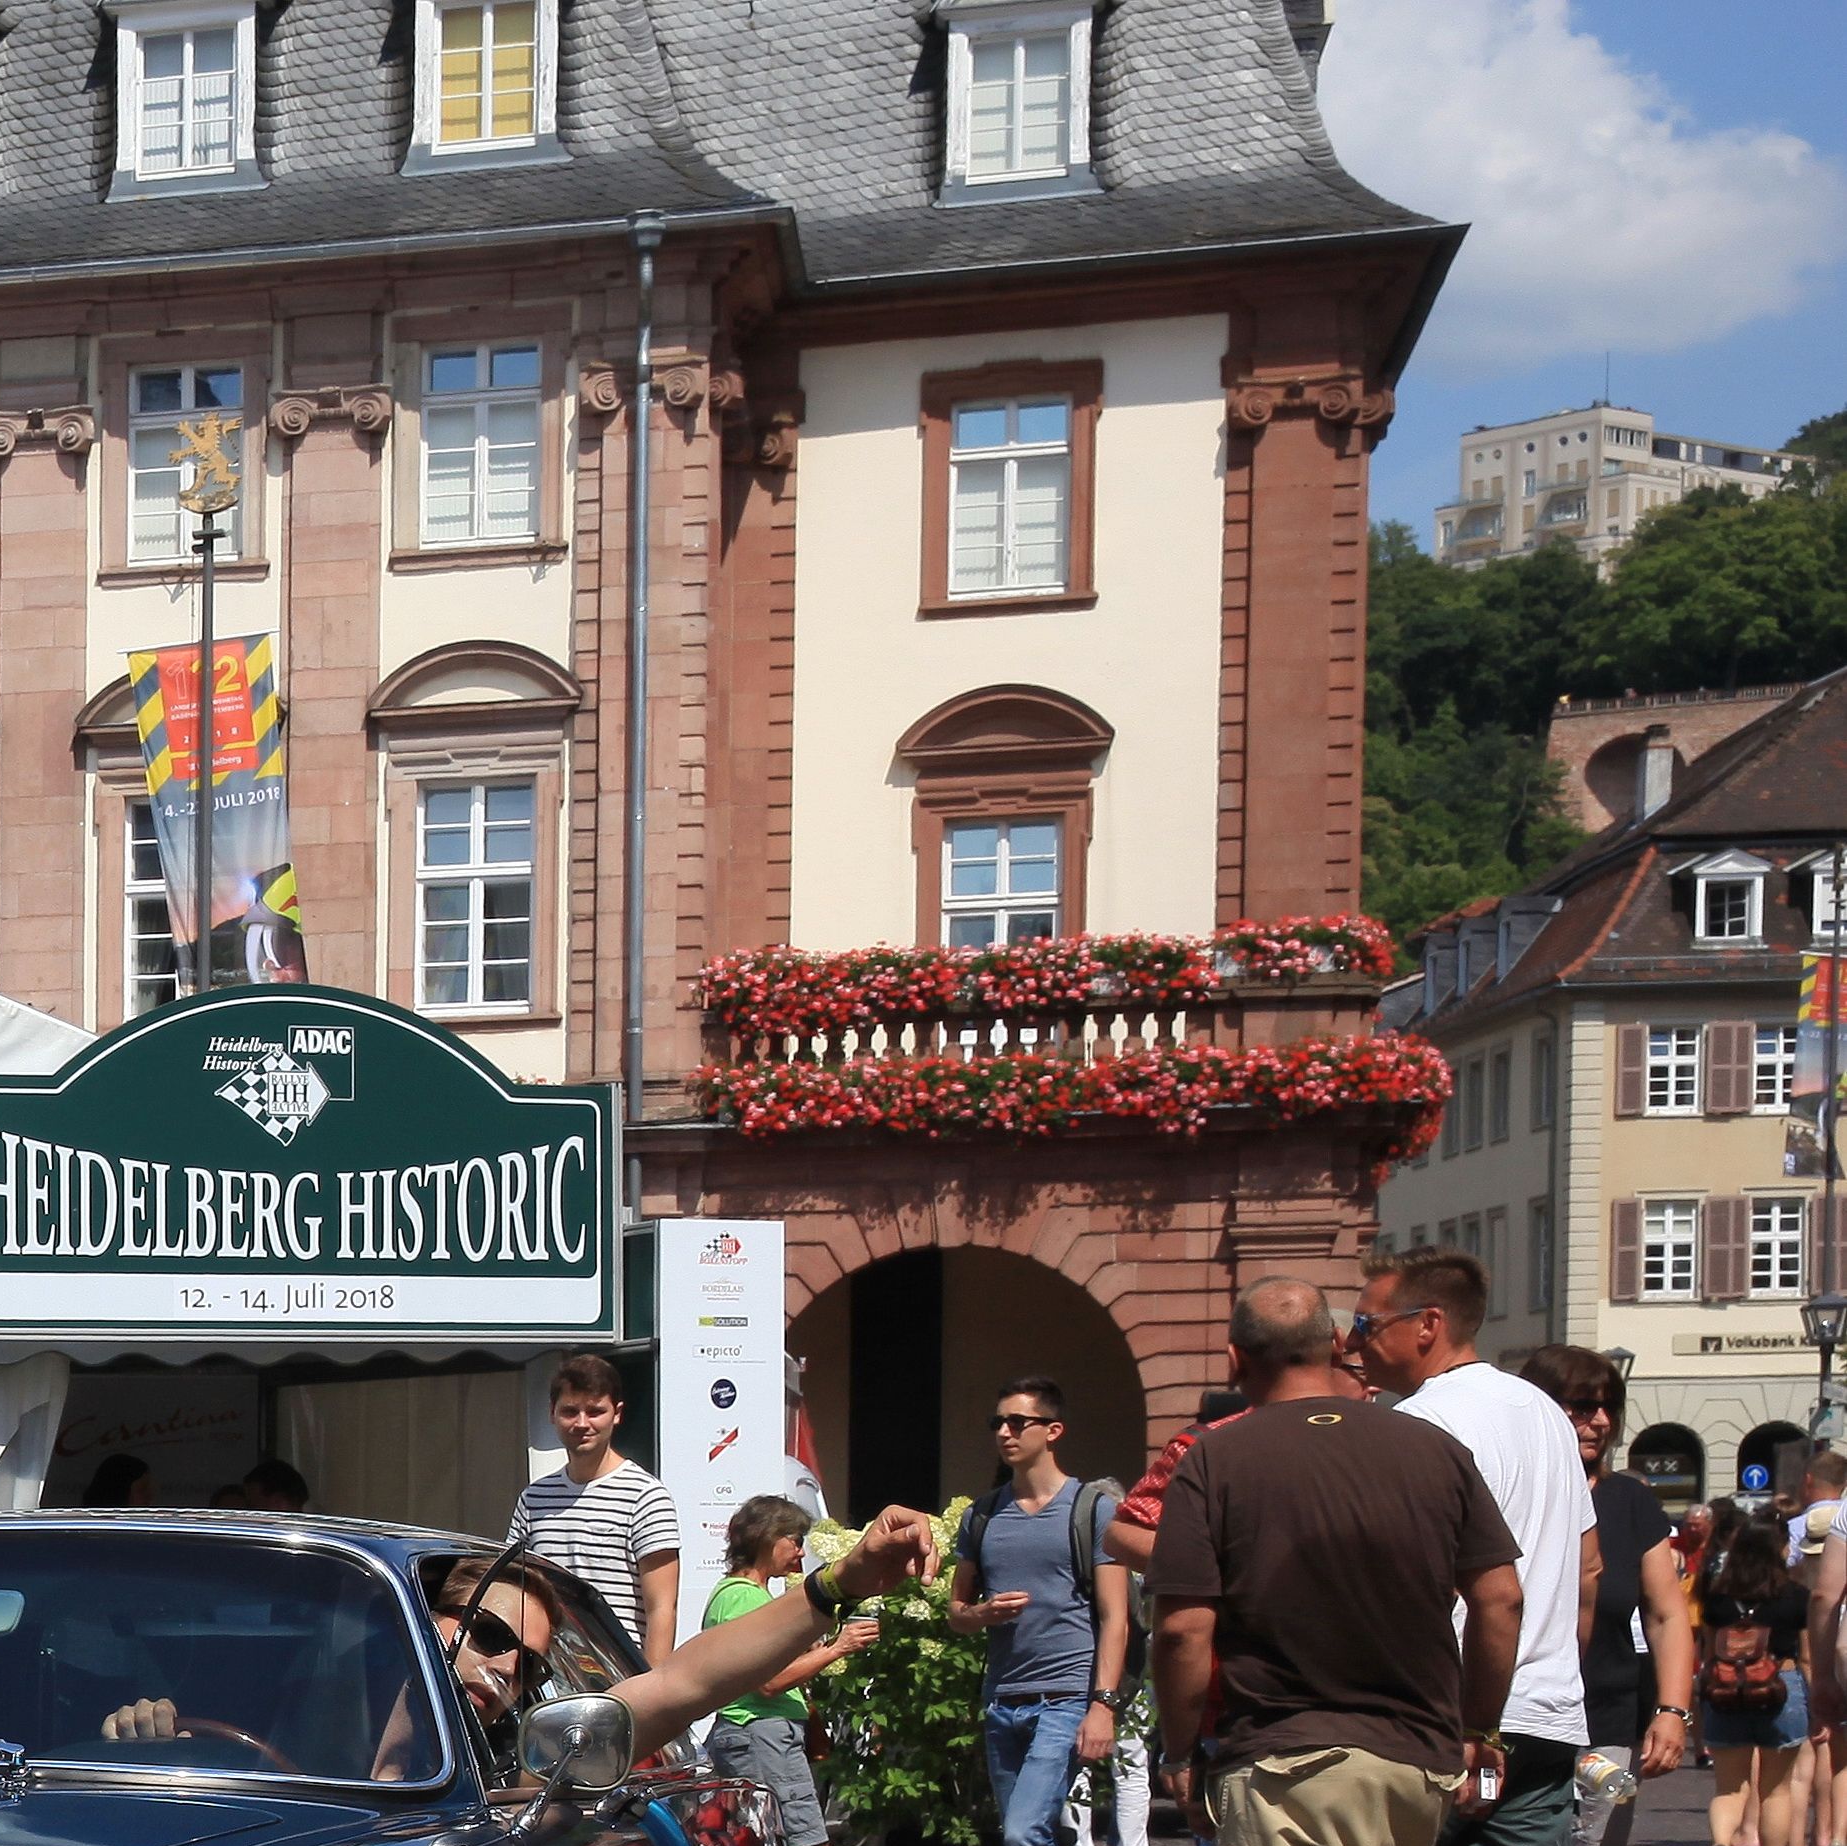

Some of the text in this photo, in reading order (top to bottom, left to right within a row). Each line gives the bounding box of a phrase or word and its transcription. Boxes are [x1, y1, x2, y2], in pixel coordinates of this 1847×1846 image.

[213, 792, 244, 811] JULI
[247, 786, 280, 806] 2018
[208, 1036, 284, 1058] Heidelberg
[292, 1029, 352, 1055] ADAC
[202, 1054, 259, 1071] Historic
[335, 1135, 588, 1264] HISTORIC
[179, 1288, 212, 1308] 12.
[239, 1289, 276, 1313] 14.
[282, 1282, 325, 1314] Juli
[334, 1284, 395, 1309] 2018
[1726, 1335, 1795, 1349] Volksbank
